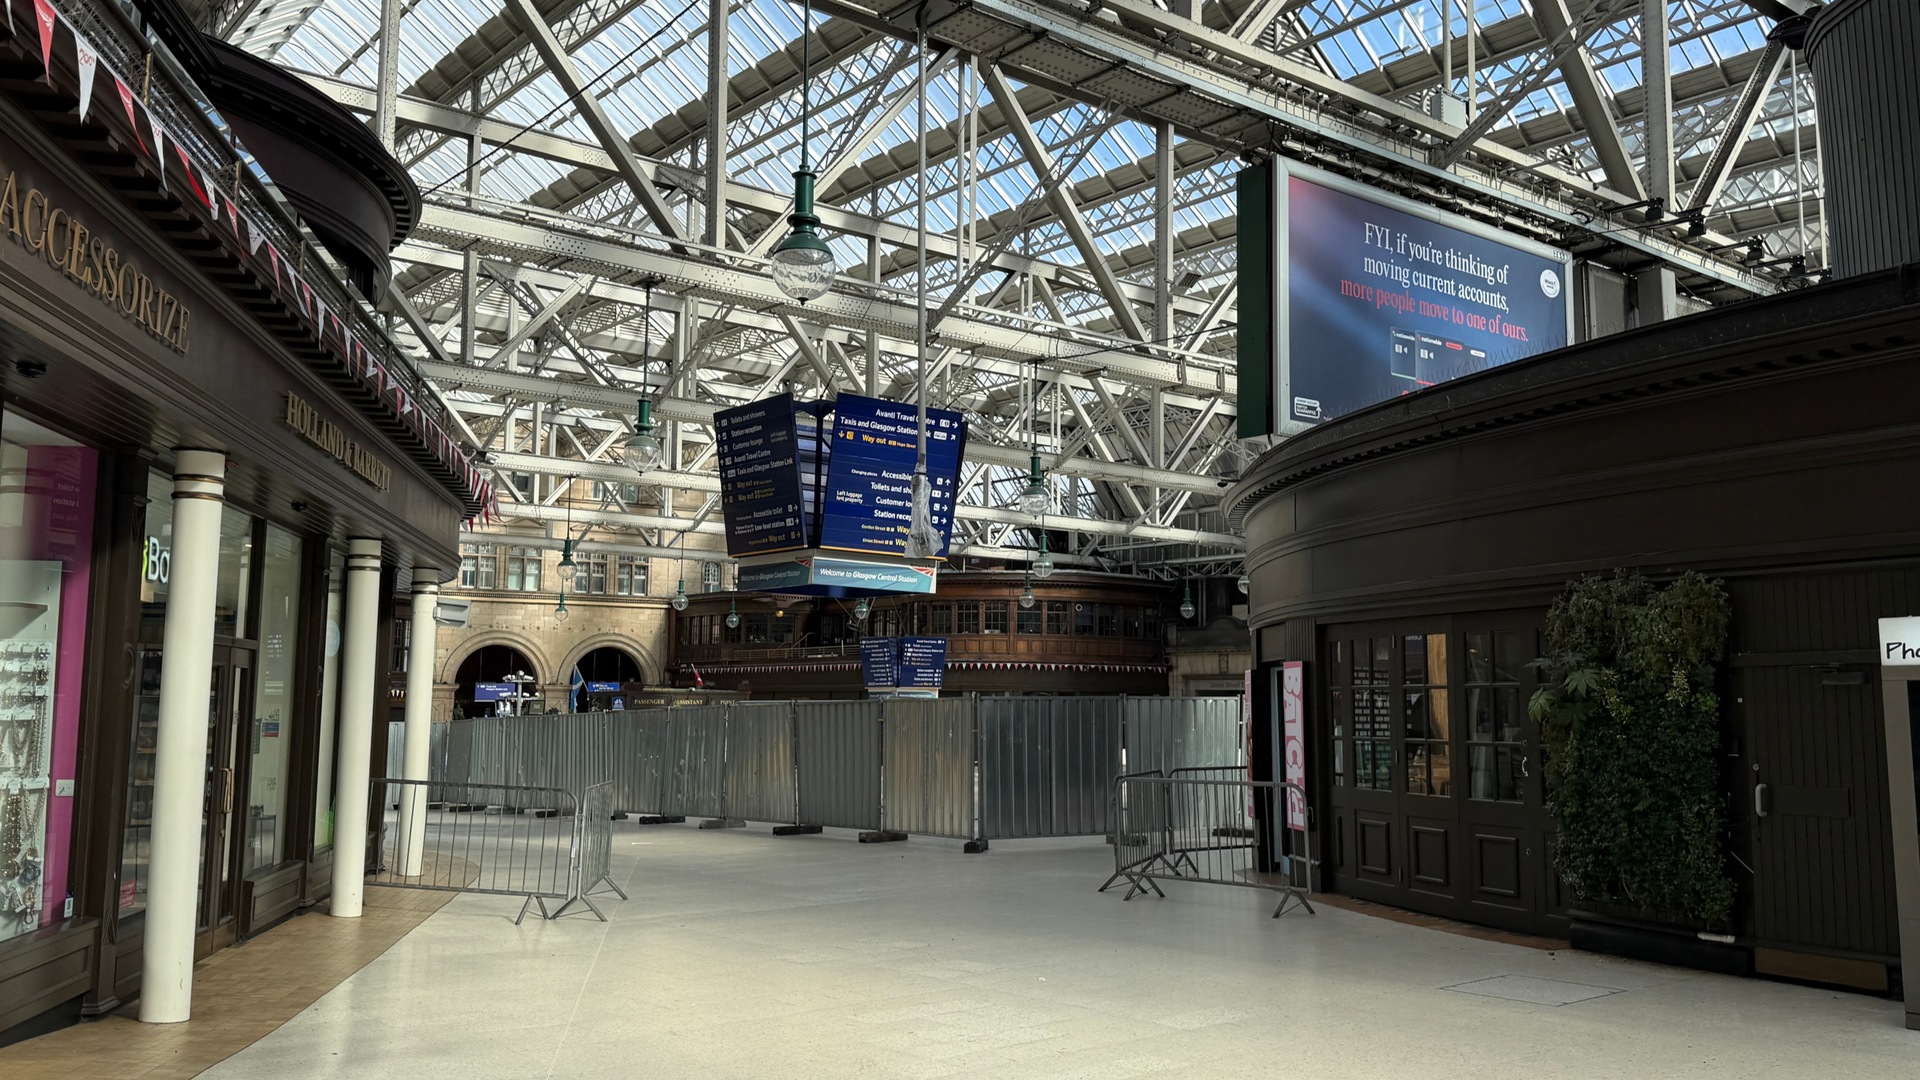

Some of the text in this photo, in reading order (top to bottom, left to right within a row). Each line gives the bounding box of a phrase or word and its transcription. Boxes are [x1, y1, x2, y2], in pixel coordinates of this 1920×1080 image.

[1364, 222, 1394, 254] FYI,
[1396, 233, 1407, 255] if
[1444, 248, 1494, 286] thinking
[1496, 265, 1509, 285] of
[0, 170, 191, 354] ACCESSORIZE
[1364, 257, 1510, 314] moving current accounts,
[1340, 279, 1529, 342] more people move to one of ours.
[876, 408, 896, 419] Avanti
[896, 412, 915, 422] Travel
[731, 425, 762, 438] Station reception
[840, 416, 857, 425] Taxis
[857, 420, 869, 428] and
[870, 421, 896, 432] Glasgow
[896, 426, 918, 436] Station
[286, 390, 392, 494] HOLLAND & BARRETT
[862, 434, 875, 443] Way
[746, 452, 758, 460] Travel
[758, 450, 771, 458] Centre
[754, 464, 770, 472] Glasgow
[770, 460, 784, 468] Station
[784, 457, 793, 466] Link
[881, 470, 912, 481] Accessible
[870, 482, 890, 491] Toilets
[876, 496, 904, 507] Customer
[874, 509, 895, 519] Station
[897, 525, 910, 535] Way
[820, 568, 845, 577] Welcome
[852, 571, 877, 581] Glasgow
[878, 573, 897, 581] Central
[898, 575, 918, 583] Station
